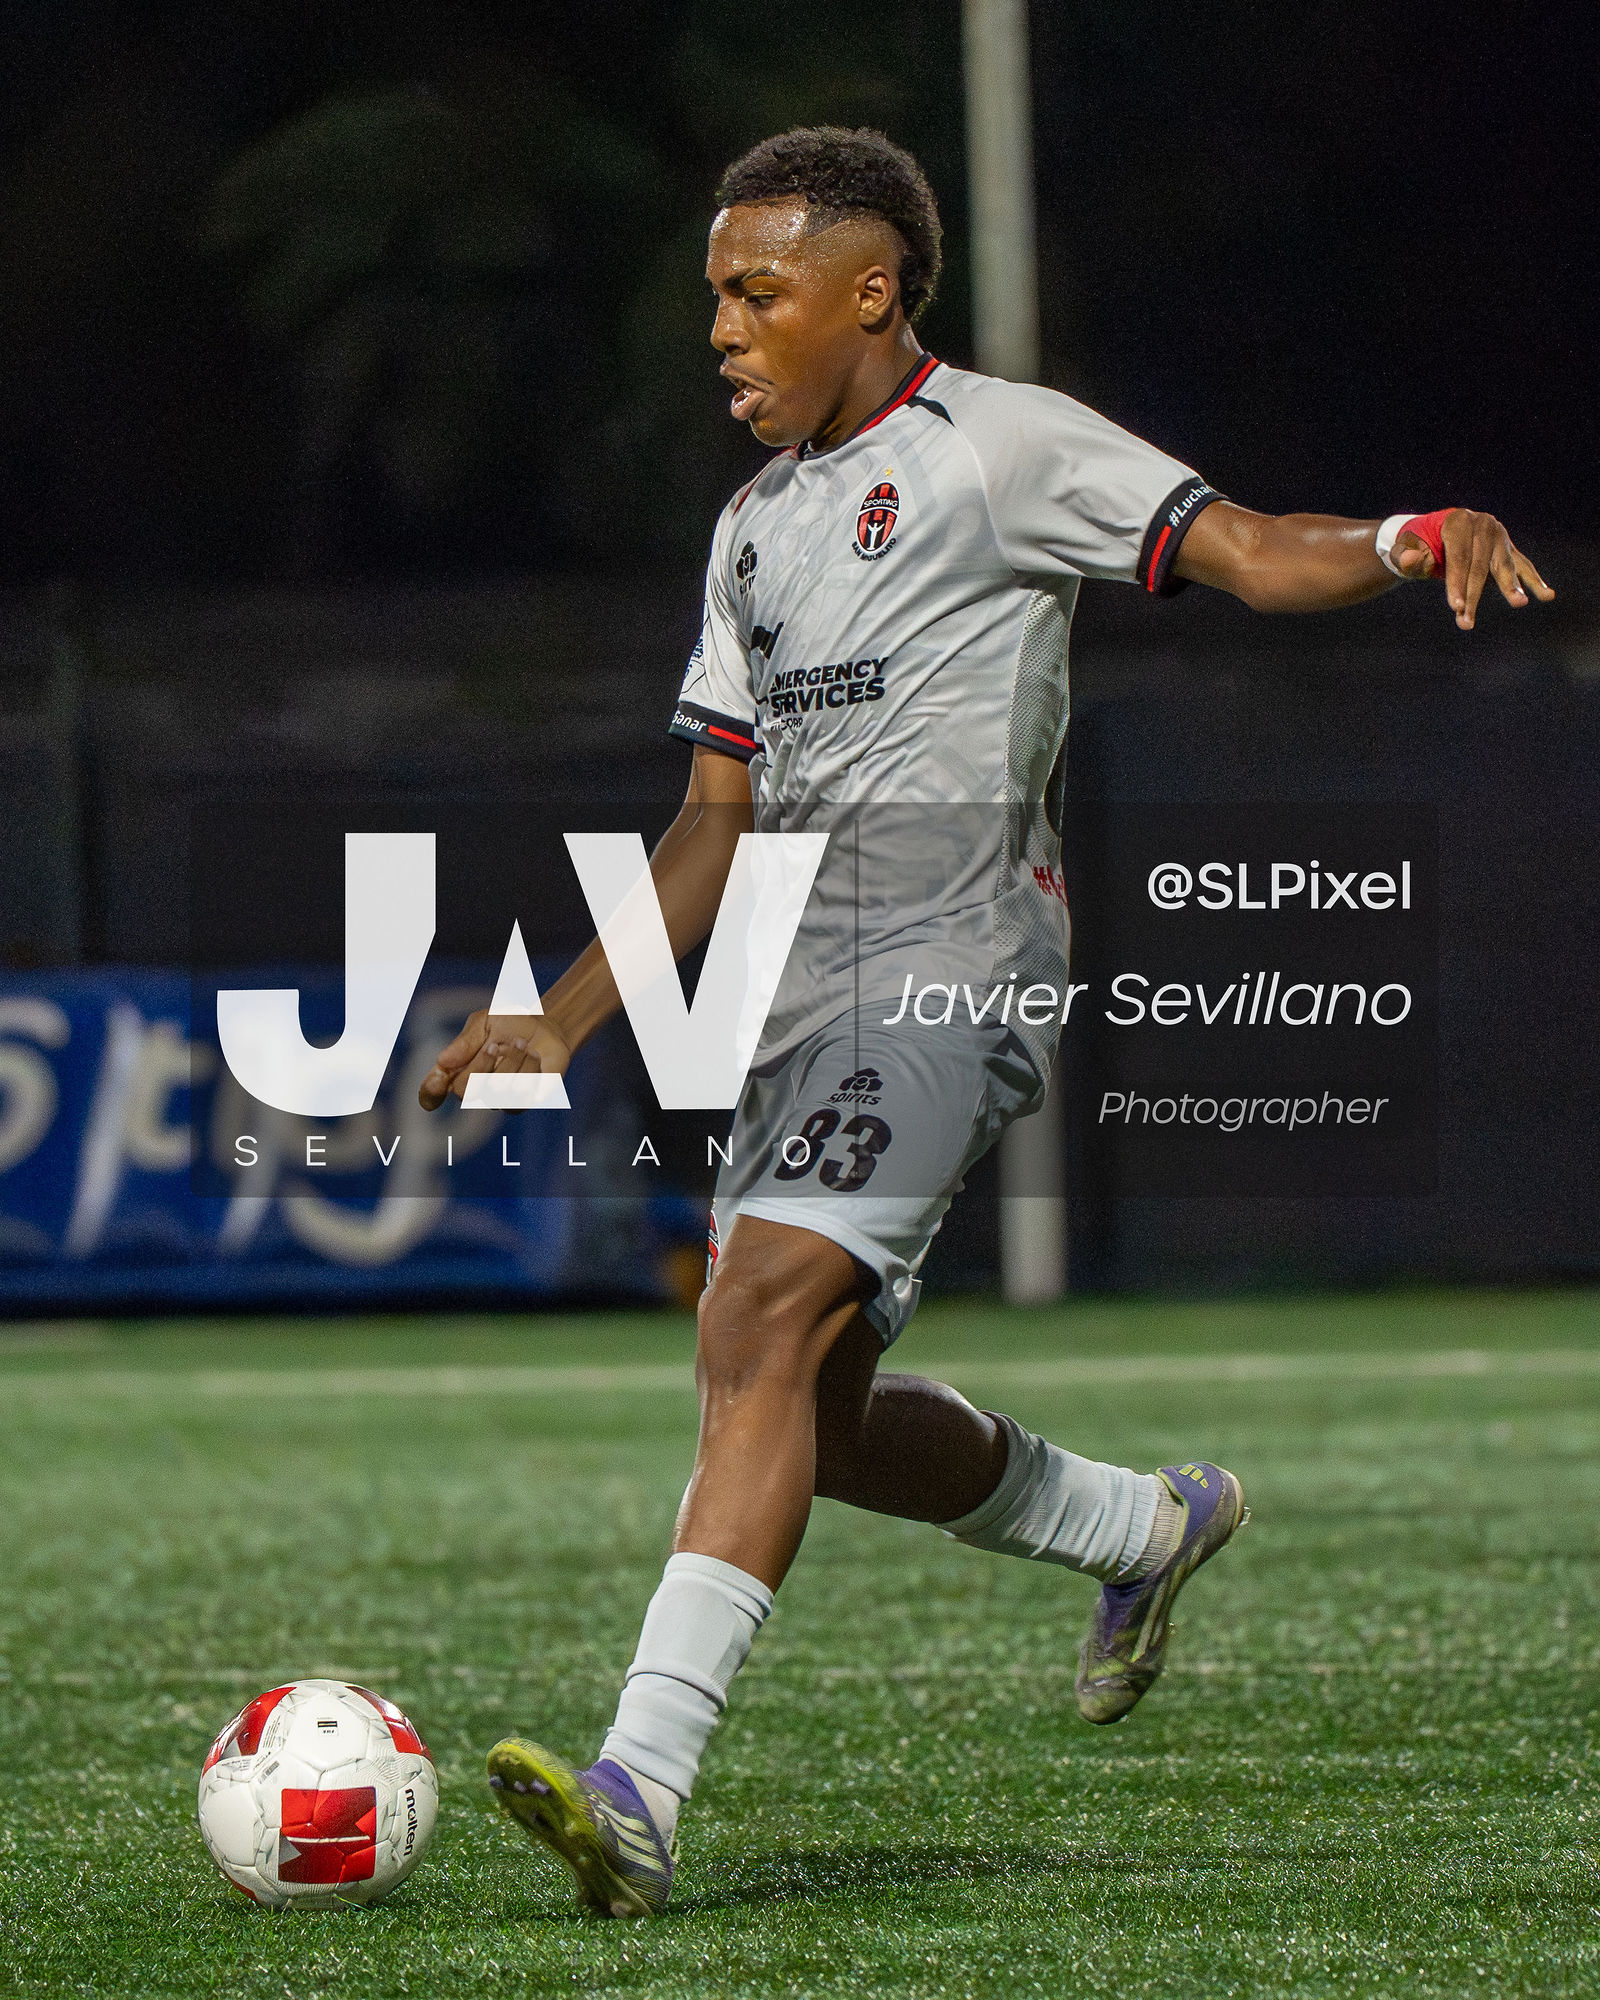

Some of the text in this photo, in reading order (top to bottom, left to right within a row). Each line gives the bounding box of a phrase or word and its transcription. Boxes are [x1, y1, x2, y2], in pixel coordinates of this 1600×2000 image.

[1168, 484, 1217, 527] #Lucha
[769, 656, 889, 693] MERGENCY
[773, 1108, 892, 1192] 83
[404, 1788, 418, 1856] molten
